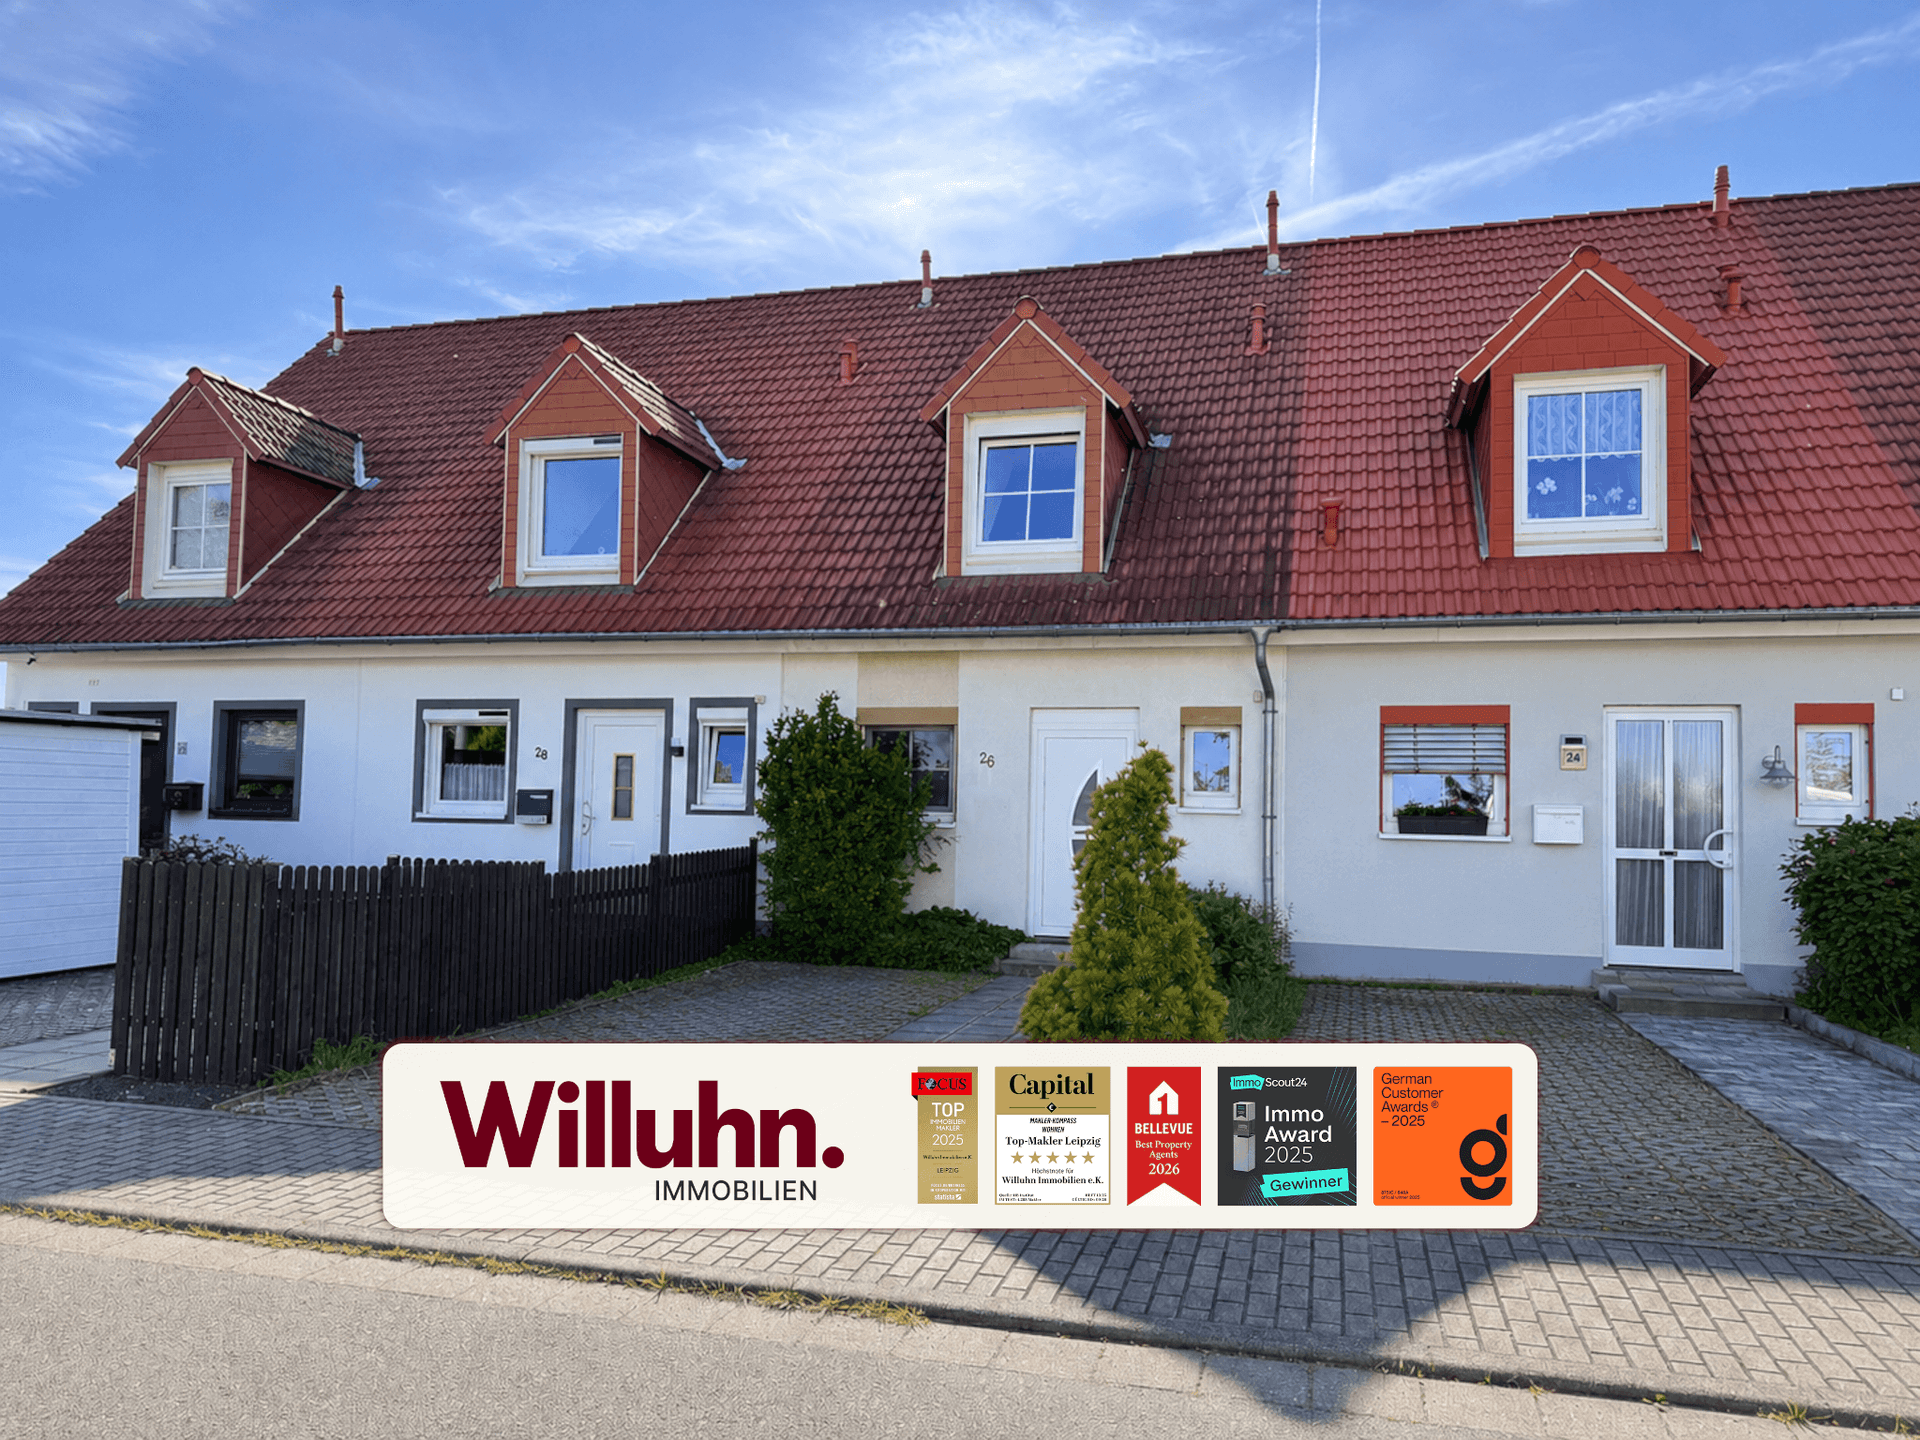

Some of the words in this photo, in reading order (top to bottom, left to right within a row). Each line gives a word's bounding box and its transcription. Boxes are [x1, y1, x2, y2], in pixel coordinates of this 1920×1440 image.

[535, 746, 548, 760] 28
[979, 751, 995, 768] 26
[1566, 752, 1580, 763] 24
